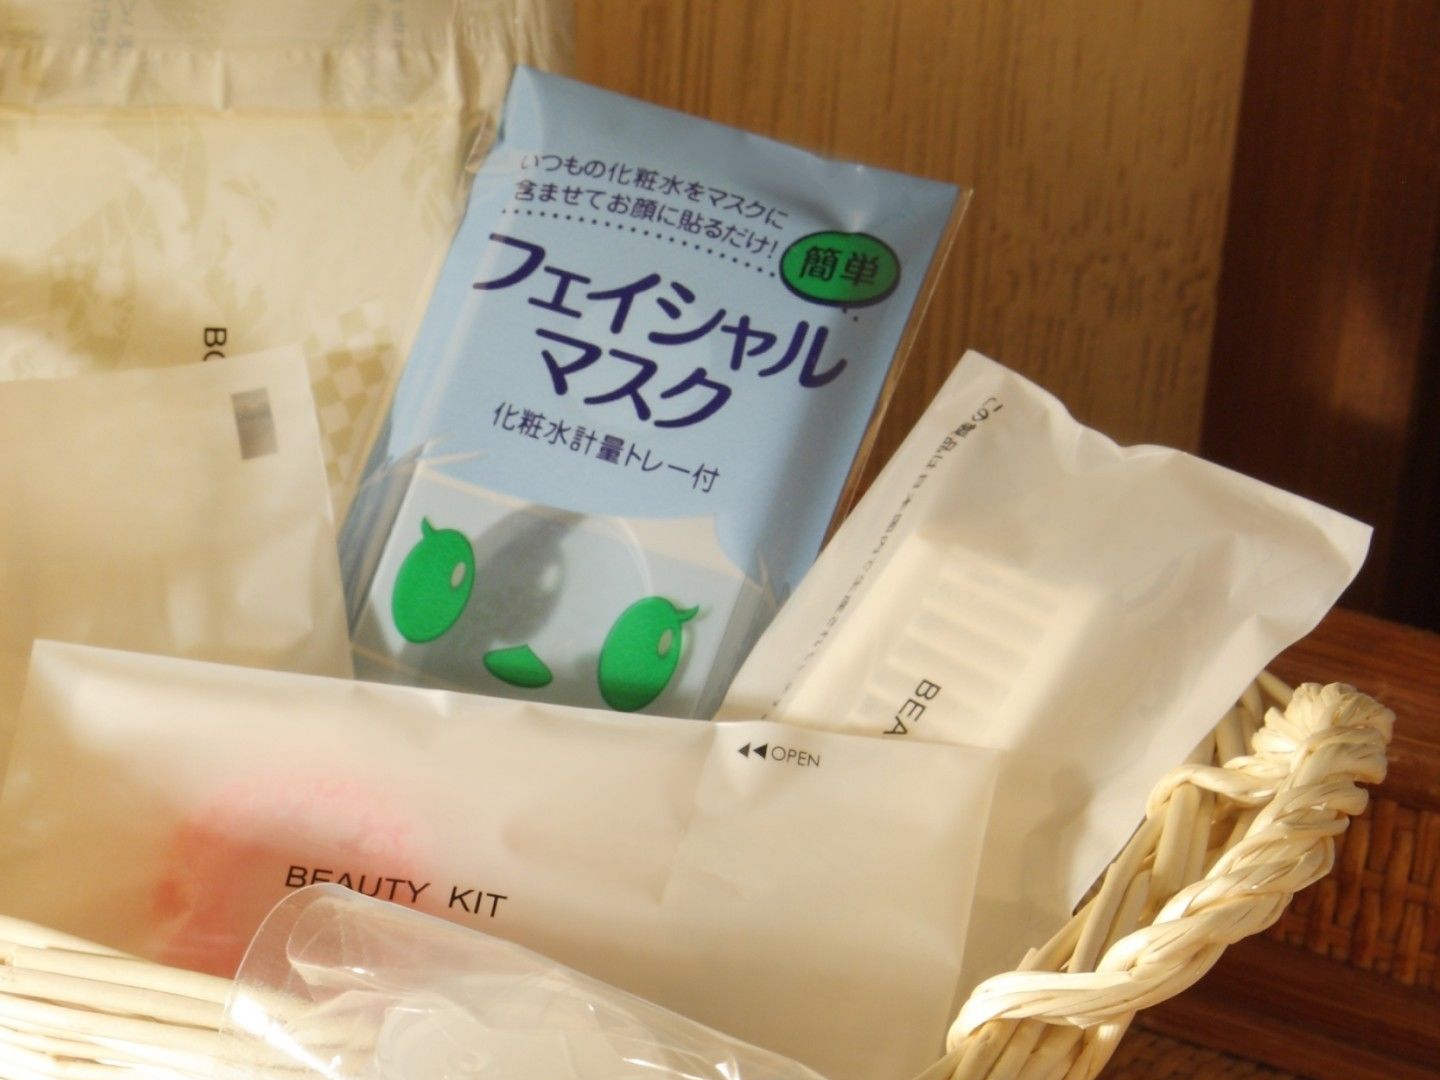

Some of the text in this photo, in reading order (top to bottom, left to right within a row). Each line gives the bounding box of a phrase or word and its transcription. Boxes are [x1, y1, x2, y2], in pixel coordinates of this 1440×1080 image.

[514, 180, 779, 259] 含ませてお顔に貼るだけ!
[520, 154, 789, 230] いつもの化粧水をマスクに
[799, 245, 880, 286] 簡単
[472, 233, 848, 388] フェイシャル
[535, 328, 732, 428] マスク
[493, 402, 720, 492] 化粧水計量トレー付
[771, 746, 820, 767] OPEN
[285, 865, 508, 918] BEAUTY KIT
